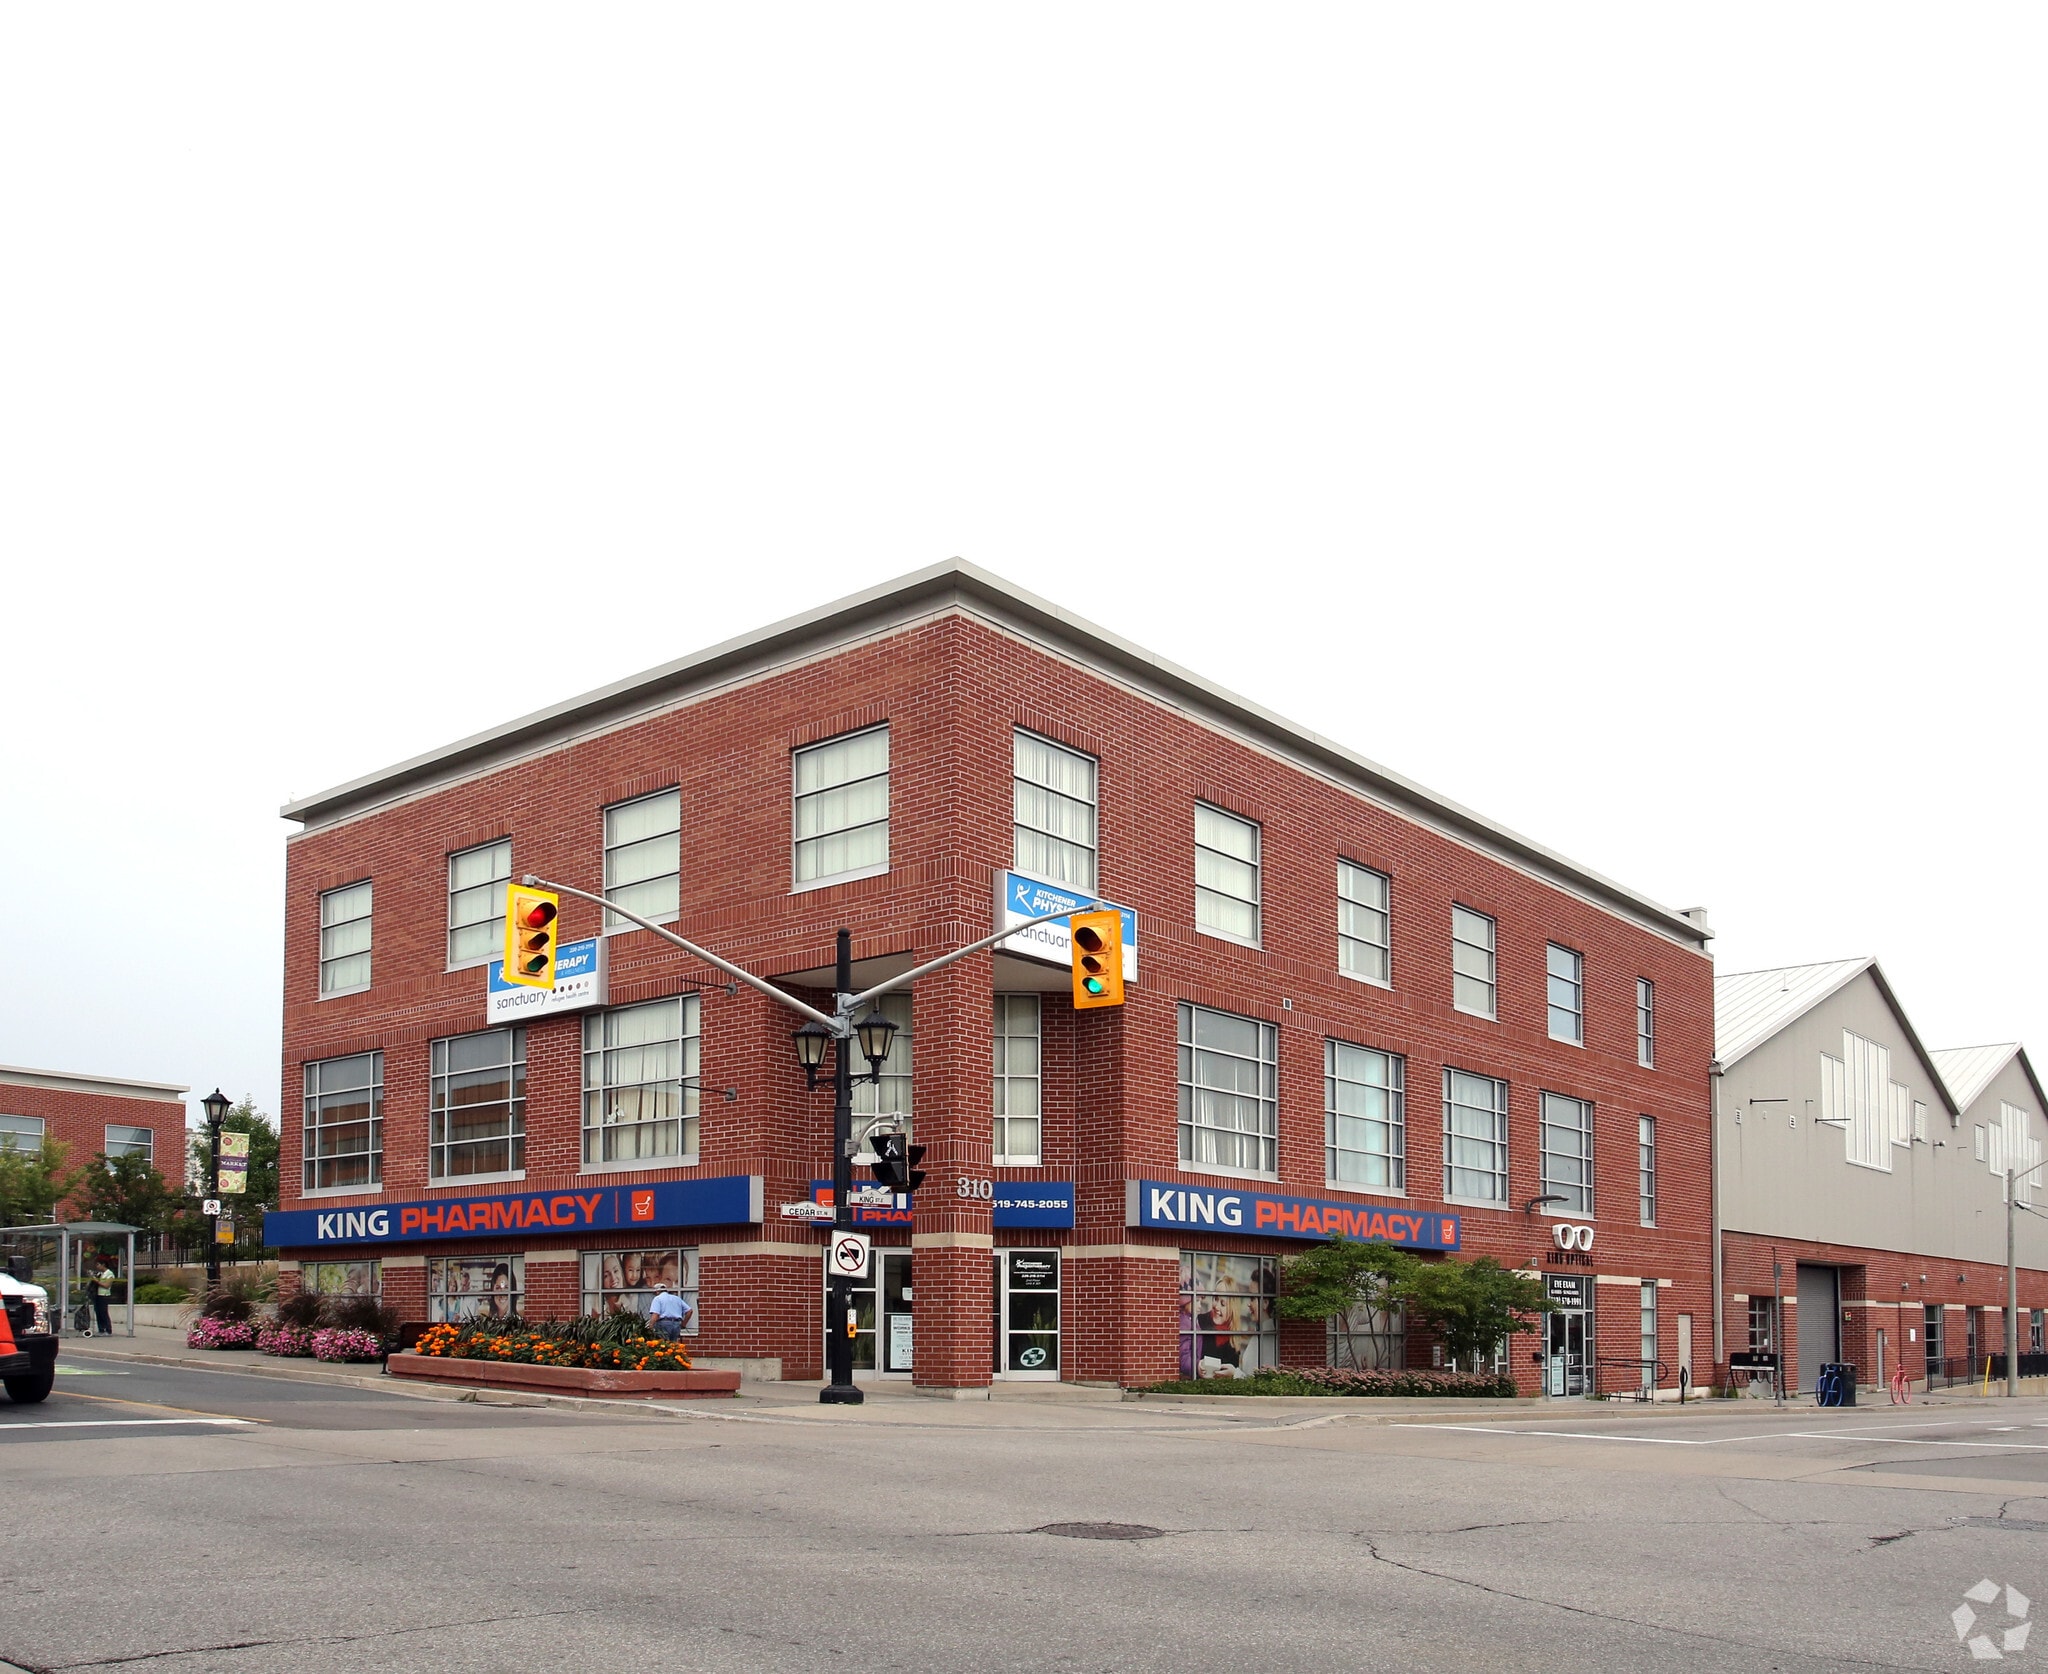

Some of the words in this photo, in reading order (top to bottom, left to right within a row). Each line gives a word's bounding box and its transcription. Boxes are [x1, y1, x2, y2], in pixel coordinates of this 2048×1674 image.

[1037, 889, 1076, 907] KITCHENER
[497, 990, 548, 1009] sanctuary
[220, 1160, 248, 1168] MARKET
[957, 1177, 993, 1200] 310
[859, 1195, 874, 1204] KING
[317, 1209, 390, 1240] KING
[400, 1193, 604, 1236] PHARMACY
[788, 1207, 816, 1216] CEDAR
[1151, 1188, 1243, 1226] KING
[1255, 1199, 1424, 1242] PHARMACY
[1547, 1252, 1563, 1264] KING
[1567, 1253, 1593, 1267] OPTICAL
[1554, 1280, 1562, 1288] EYE
[1563, 1280, 1575, 1288] EXAM
